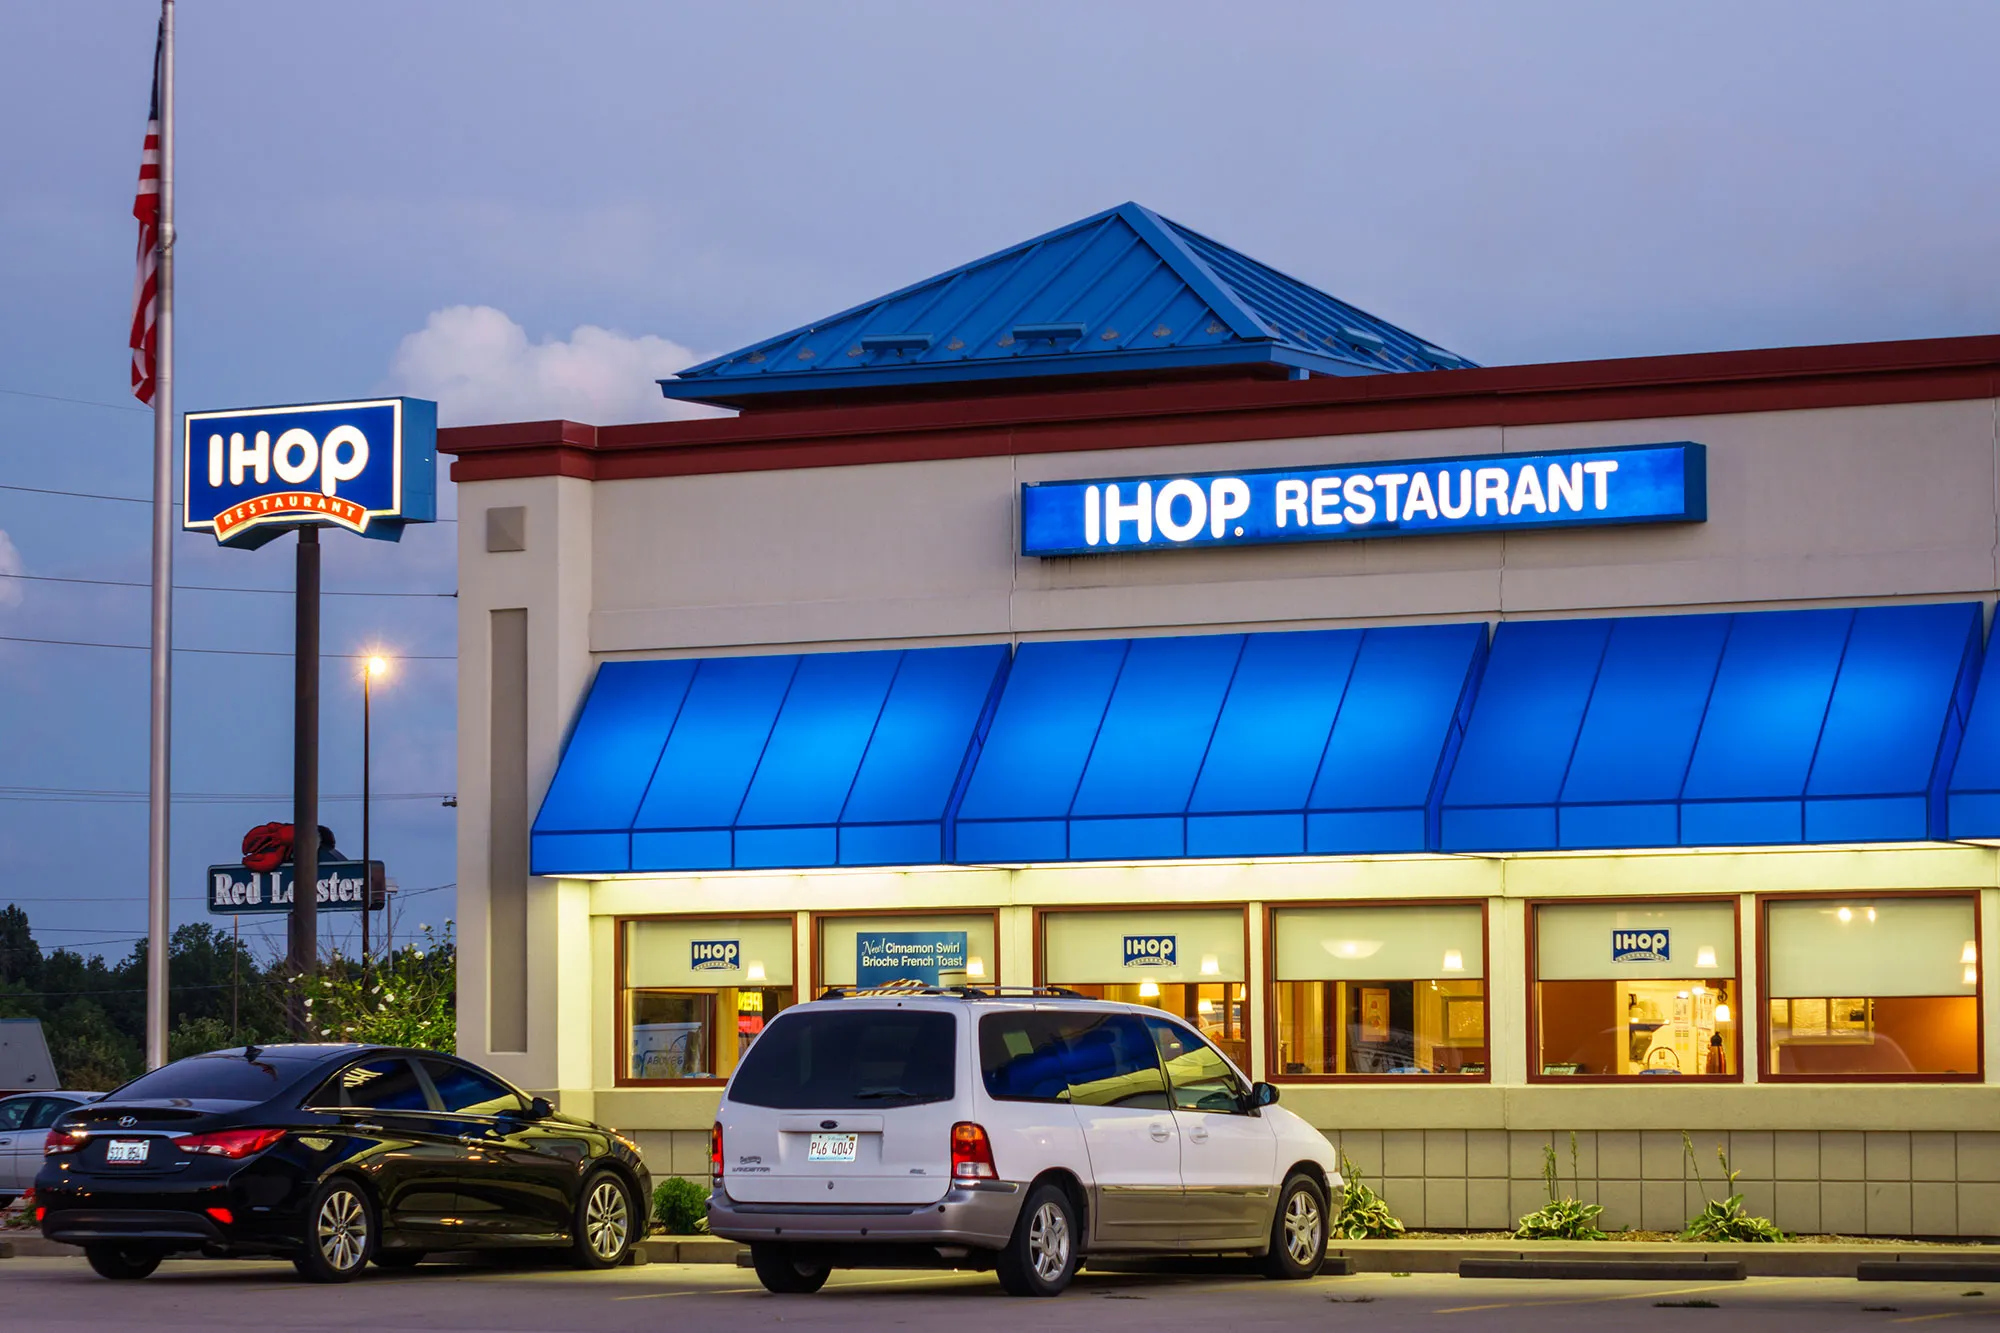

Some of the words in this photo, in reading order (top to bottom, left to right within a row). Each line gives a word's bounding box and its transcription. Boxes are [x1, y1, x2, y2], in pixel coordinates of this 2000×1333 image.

[209, 425, 369, 497] IHOP
[223, 496, 357, 525] RESTAURANT
[1084, 478, 1250, 546] IHOP
[1276, 460, 1619, 528] RESTAURANT
[213, 872, 262, 905] Red
[694, 943, 737, 963] IHOP
[885, 942, 934, 954] Cinnamon
[936, 942, 960, 953] Swirl
[1126, 939, 1173, 959] IHOP
[1616, 933, 1667, 954] IHOP
[863, 956, 899, 967] Brioche
[901, 955, 934, 966] French
[936, 955, 962, 966] Toast
[811, 1142, 827, 1155] P46
[832, 1142, 854, 1155] 4049
